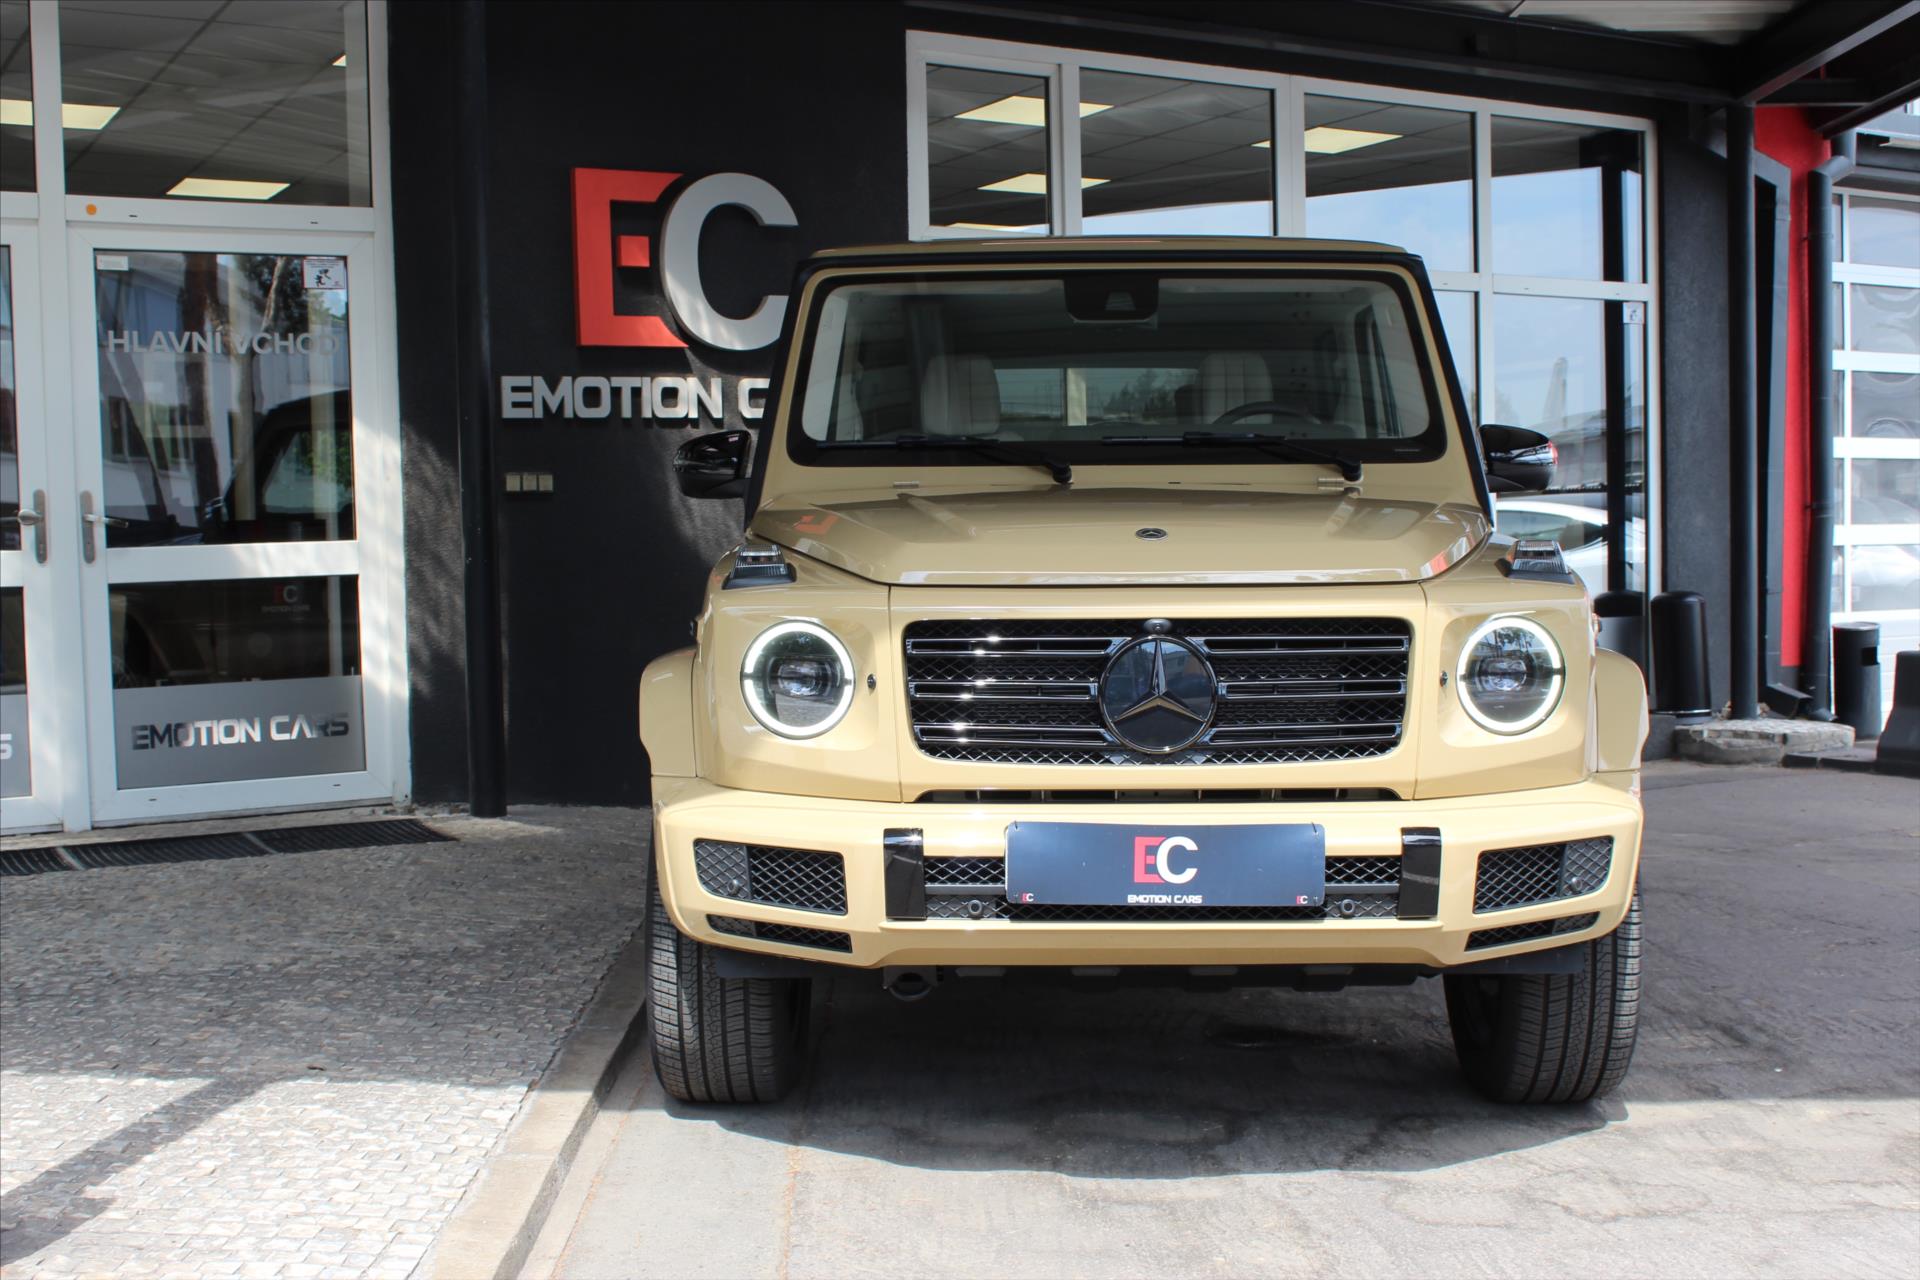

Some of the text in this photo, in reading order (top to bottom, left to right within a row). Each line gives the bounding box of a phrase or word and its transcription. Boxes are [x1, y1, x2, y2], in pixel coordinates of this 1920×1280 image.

[571, 167, 799, 351] EC
[106, 325, 340, 356] HLAVNÍ VCHOD
[501, 375, 724, 420] EMOTION
[131, 712, 349, 750] EMOTION CARS
[1133, 836, 1199, 884] EC
[1127, 894, 1203, 904] EMOTION CARS
